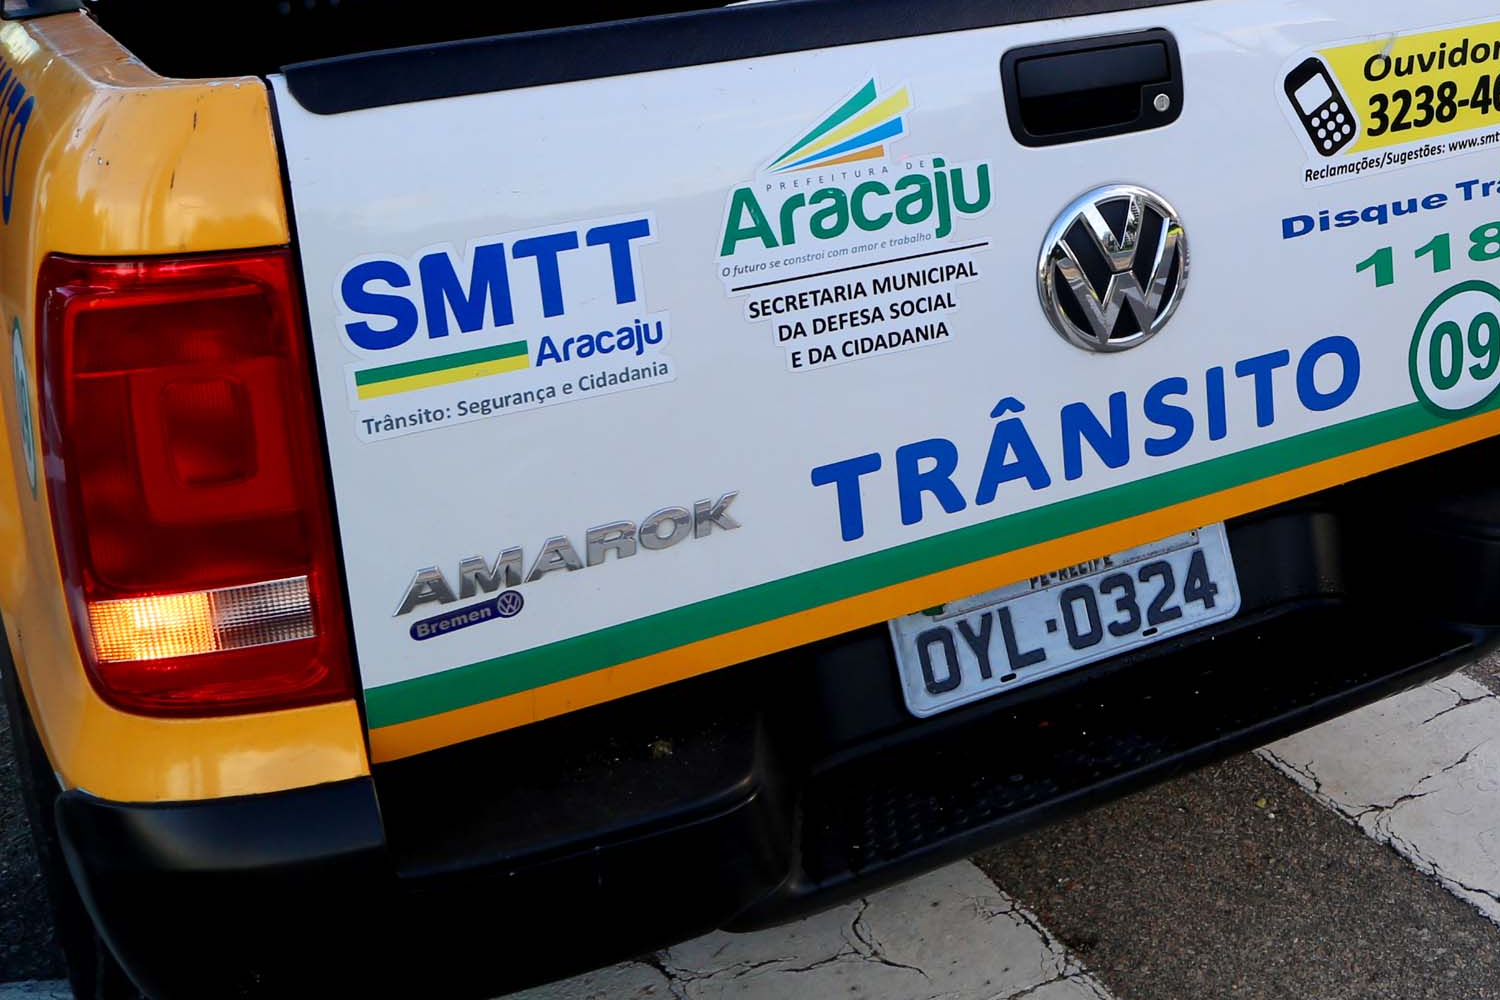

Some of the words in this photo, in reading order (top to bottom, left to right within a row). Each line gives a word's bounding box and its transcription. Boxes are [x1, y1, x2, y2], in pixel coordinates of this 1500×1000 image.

[766, 165, 889, 193] PREFEITURA
[905, 160, 925, 170] DE
[1304, 143, 1446, 183] Reclamações/Sugestões:
[720, 157, 992, 257] Aracaju
[1281, 191, 1449, 240] Disque
[721, 266, 731, 278] O
[731, 260, 767, 277] futuro
[769, 258, 781, 269] se
[827, 246, 849, 257] com
[851, 241, 879, 254] amor
[880, 240, 888, 249] e
[889, 232, 932, 248] trabalho
[340, 218, 651, 351] SMTT
[748, 281, 868, 319] SECRETARIA
[872, 260, 979, 296] MUNICIPAL
[778, 321, 807, 342] DA
[812, 306, 885, 336] DEFESA
[889, 292, 957, 320] SOCIAL
[535, 318, 664, 368] Aracaju
[791, 351, 803, 369] E
[808, 344, 837, 366] DA
[841, 321, 949, 358] CIDADANIA
[1428, 311, 1500, 391] 09
[361, 406, 451, 436] Trânsito:
[456, 385, 557, 416] Segurança
[562, 382, 574, 396] e
[578, 359, 669, 393] Cidadania
[810, 335, 1361, 542] TRÂNSITO
[391, 490, 742, 617] AMAROK
[415, 605, 492, 638] Bremen
